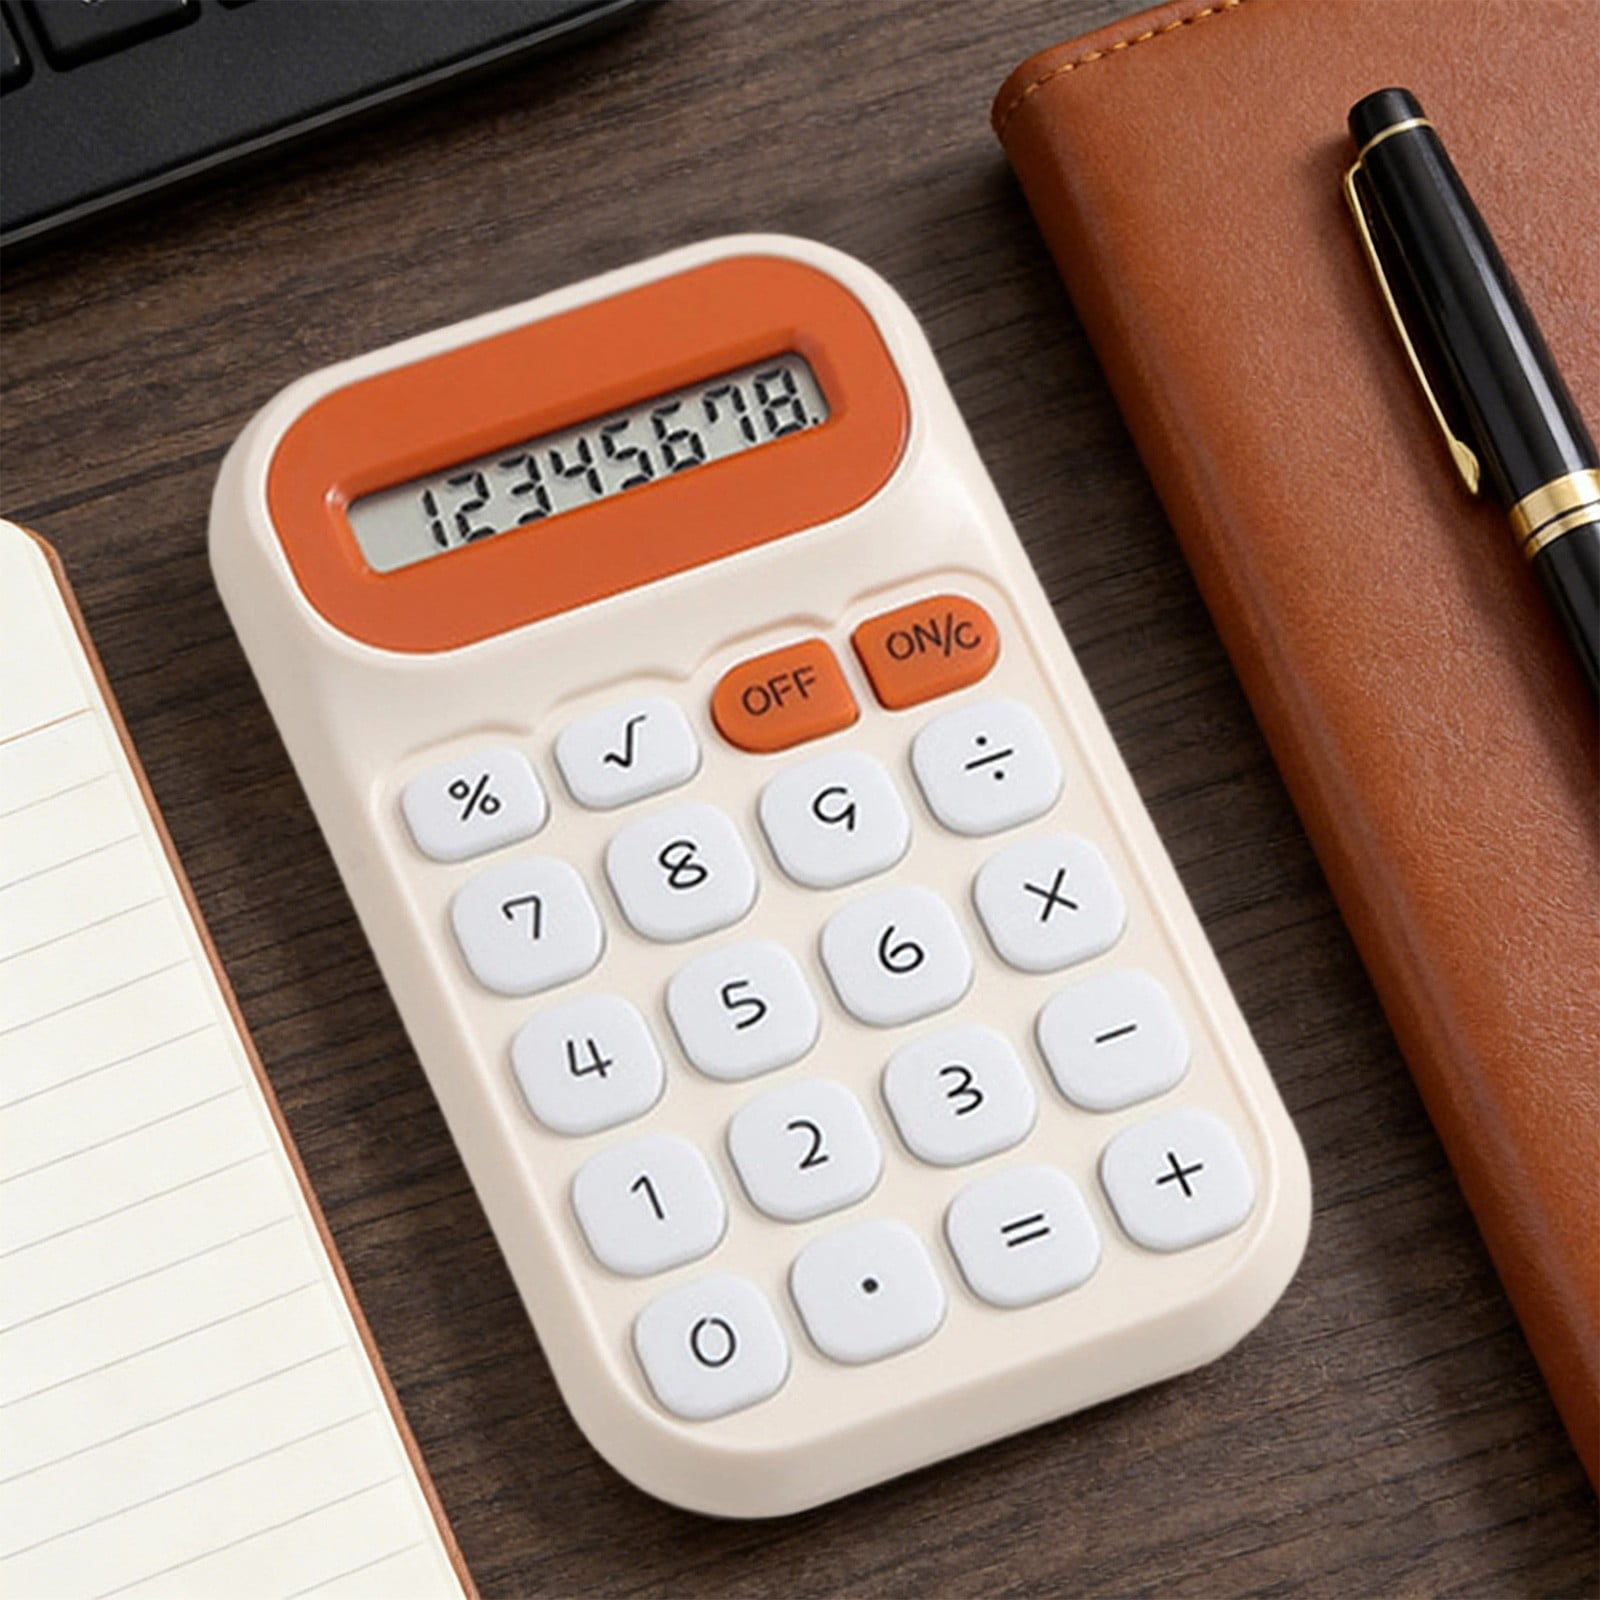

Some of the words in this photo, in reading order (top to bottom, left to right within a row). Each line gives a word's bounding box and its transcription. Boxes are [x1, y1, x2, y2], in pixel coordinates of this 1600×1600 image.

[886, 612, 981, 660] ON/C
[742, 665, 817, 716] OFF
[449, 775, 500, 820] %
[812, 786, 855, 831] 9
[659, 841, 707, 889] 8
[502, 896, 541, 939] 7
[879, 926, 924, 973] 6
[722, 981, 766, 1029] 5
[567, 1040, 612, 1077] 4
[940, 1066, 983, 1115] 3
[788, 1121, 828, 1169] 2
[632, 1176, 664, 1219] 1
[1157, 1153, 1202, 1197] +
[1001, 1214, 1049, 1247] =
[691, 1318, 736, 1367] 0
